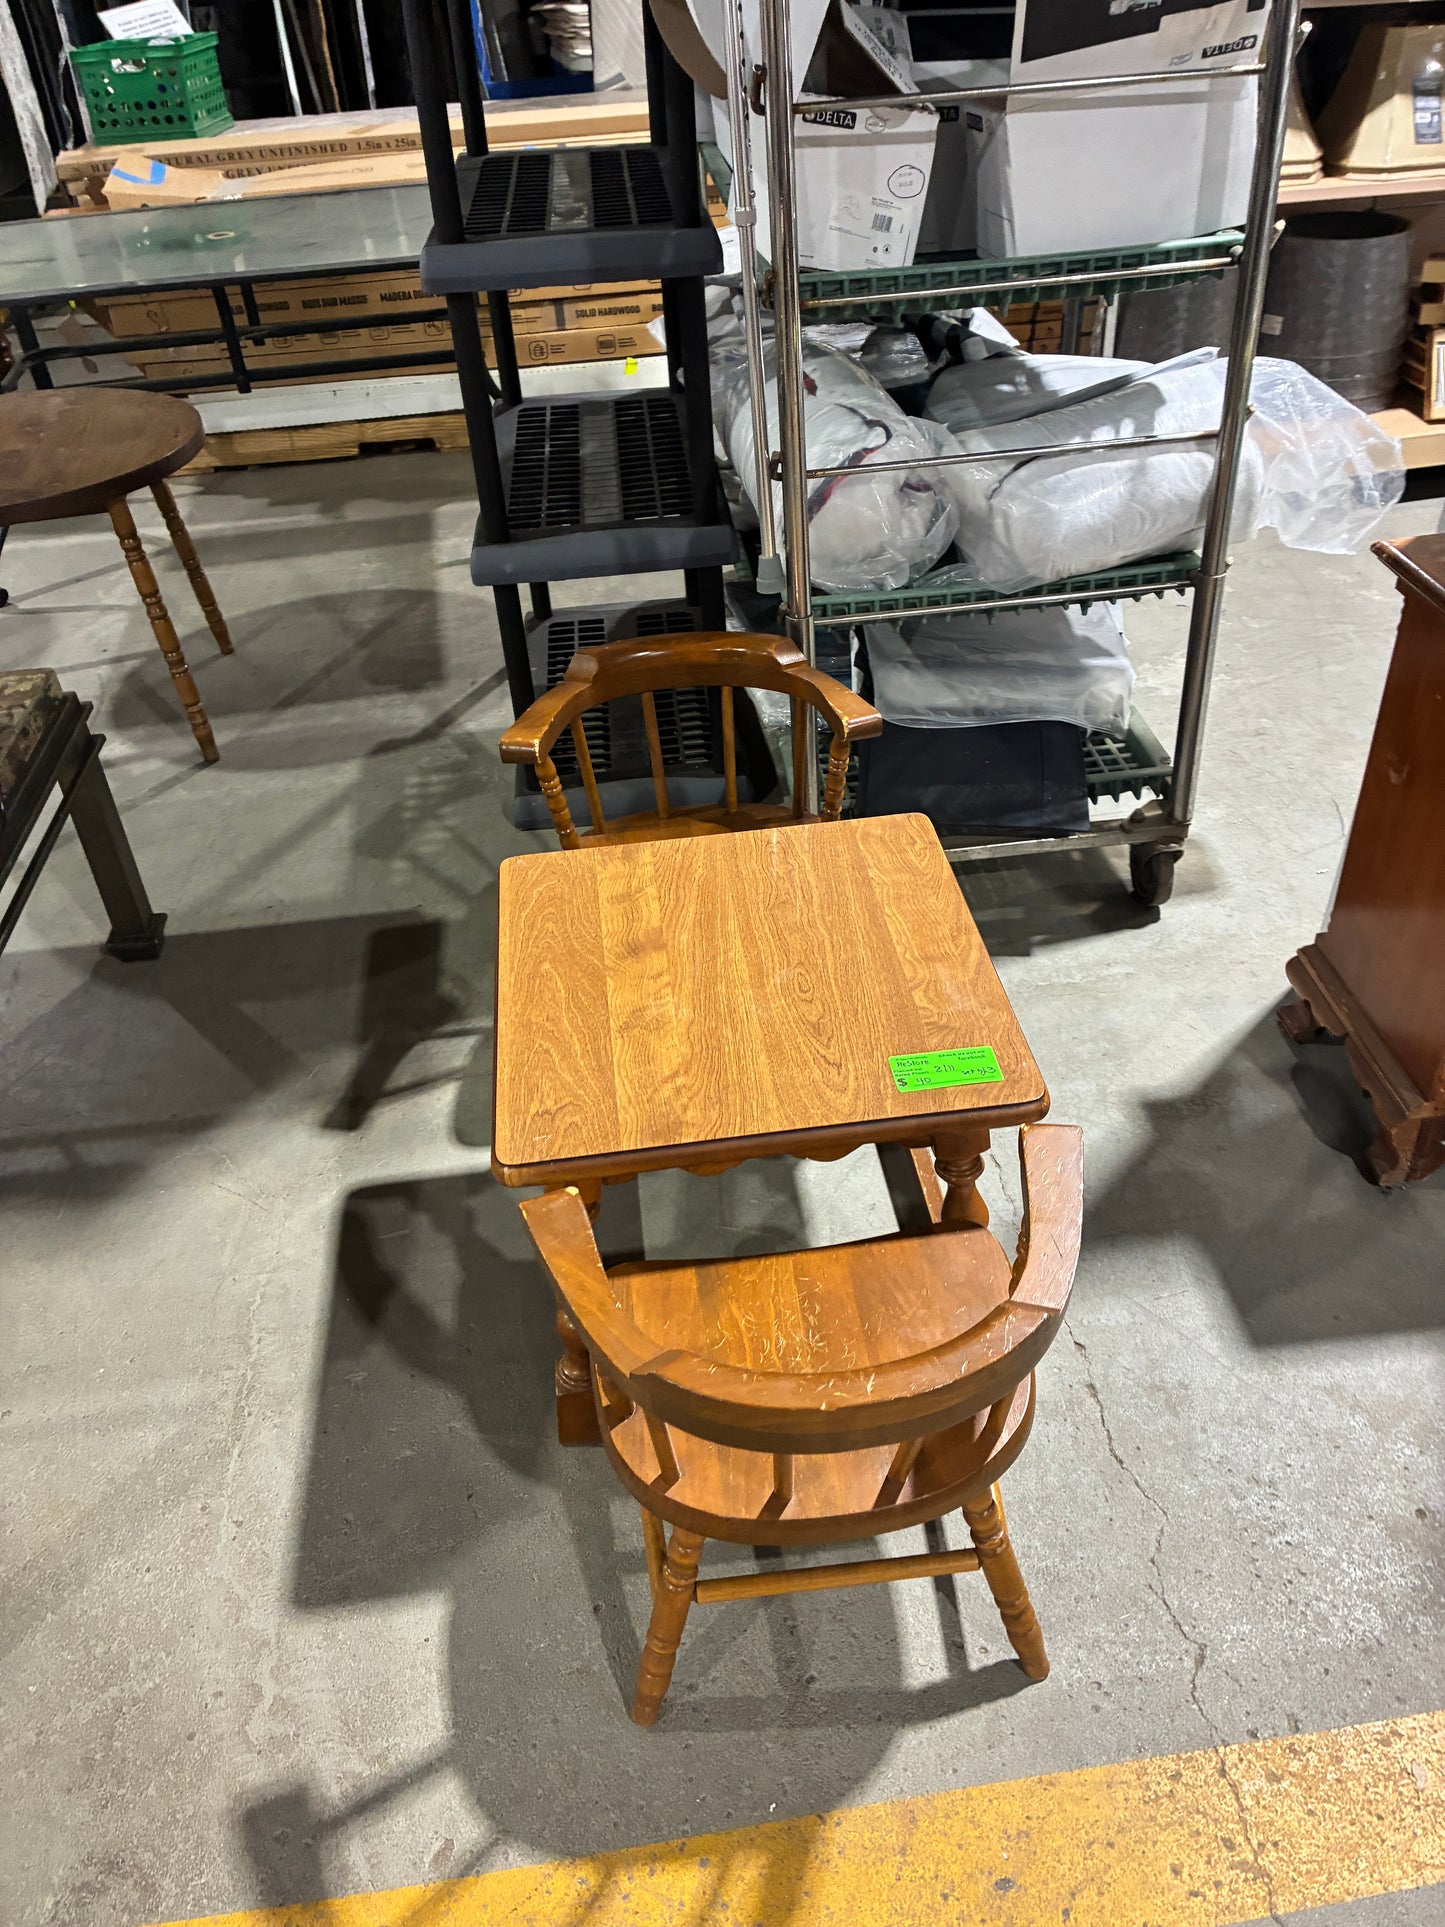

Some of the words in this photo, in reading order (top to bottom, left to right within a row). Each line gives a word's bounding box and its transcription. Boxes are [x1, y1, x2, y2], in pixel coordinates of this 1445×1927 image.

[1206, 39, 1243, 55] DELTA
[816, 111, 853, 127] DELTA
[216, 149, 254, 161] GREY
[260, 142, 348, 158] UNFINISHED
[357, 139, 382, 151] 1.5in
[394, 138, 417, 148] 25in
[380, 290, 413, 302] MADERA
[575, 308, 597, 319] SOLID
[598, 305, 641, 318] HARDWOOD
[896, 1060, 929, 1068] ReStore
[897, 1078, 908, 1087] $
[915, 1077, 932, 1086] 40
